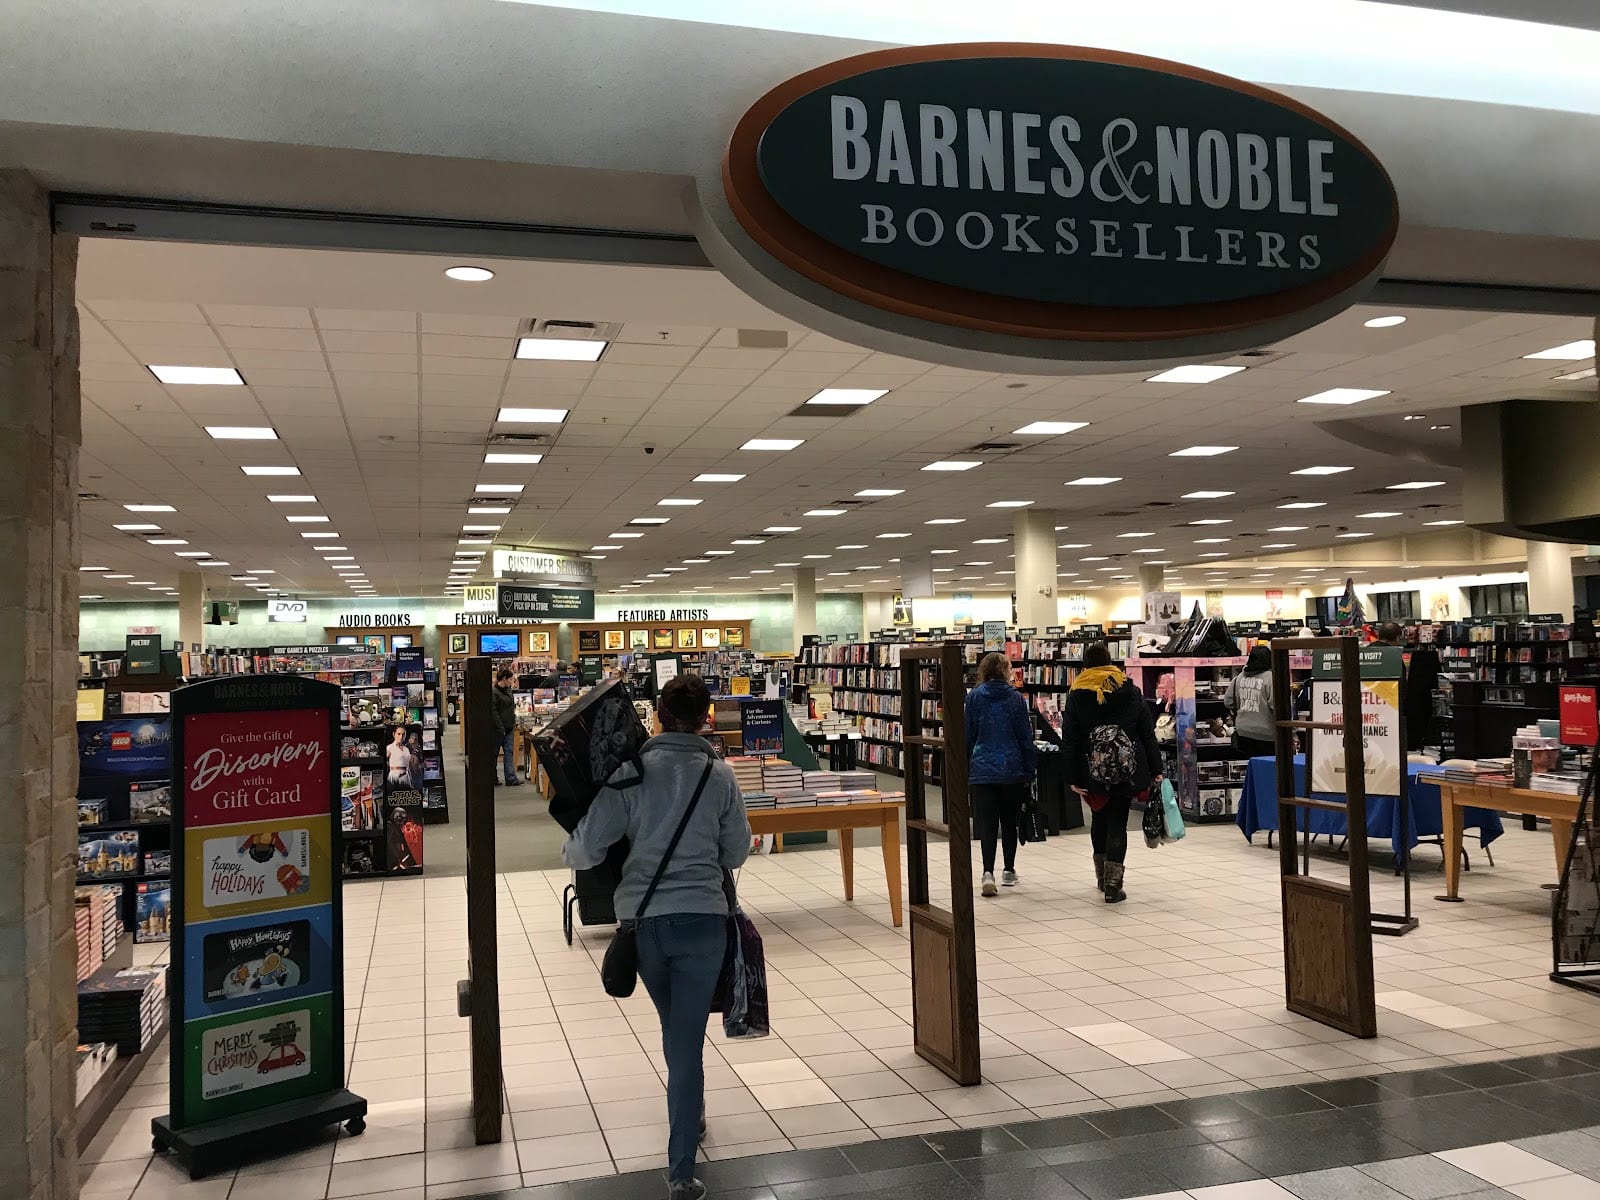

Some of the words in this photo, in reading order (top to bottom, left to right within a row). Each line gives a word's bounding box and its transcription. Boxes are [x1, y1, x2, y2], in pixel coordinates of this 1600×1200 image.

[830, 94, 1338, 216] BARNES&NOBLE
[860, 203, 1321, 270] BOOKSELLERS
[508, 554, 553, 573] CUSTOMER
[467, 588, 496, 601] MUSI
[523, 592, 538, 602] ONLINE
[275, 602, 304, 612] DVD
[514, 601, 524, 611] PICK
[525, 602, 530, 611] UP
[536, 602, 549, 611] STORE
[339, 614, 371, 627] AUDIO
[374, 613, 411, 627] BOOKS
[618, 610, 666, 622] FEATURED
[670, 609, 709, 621] ARTISTS
[130, 639, 151, 647] POETRY
[1323, 653, 1335, 661] HOW
[1364, 652, 1382, 660] VISIT?
[220, 733, 244, 744] Give
[245, 731, 262, 742] the
[263, 730, 282, 741] Gift
[282, 729, 293, 740] of
[1363, 725, 1388, 737] HANCE
[112, 736, 131, 746] LEGO
[190, 741, 324, 792] Discovery
[242, 775, 265, 787] with
[266, 777, 273, 785] a
[212, 788, 250, 810] Gift
[254, 783, 301, 806] Card
[388, 790, 421, 799] STAR
[388, 796, 422, 806] WARS
[211, 855, 244, 875] happy
[210, 873, 266, 896] HOLIDAYS
[213, 1029, 254, 1056] MERRY
[207, 1044, 258, 1076] CHRISTMAS
